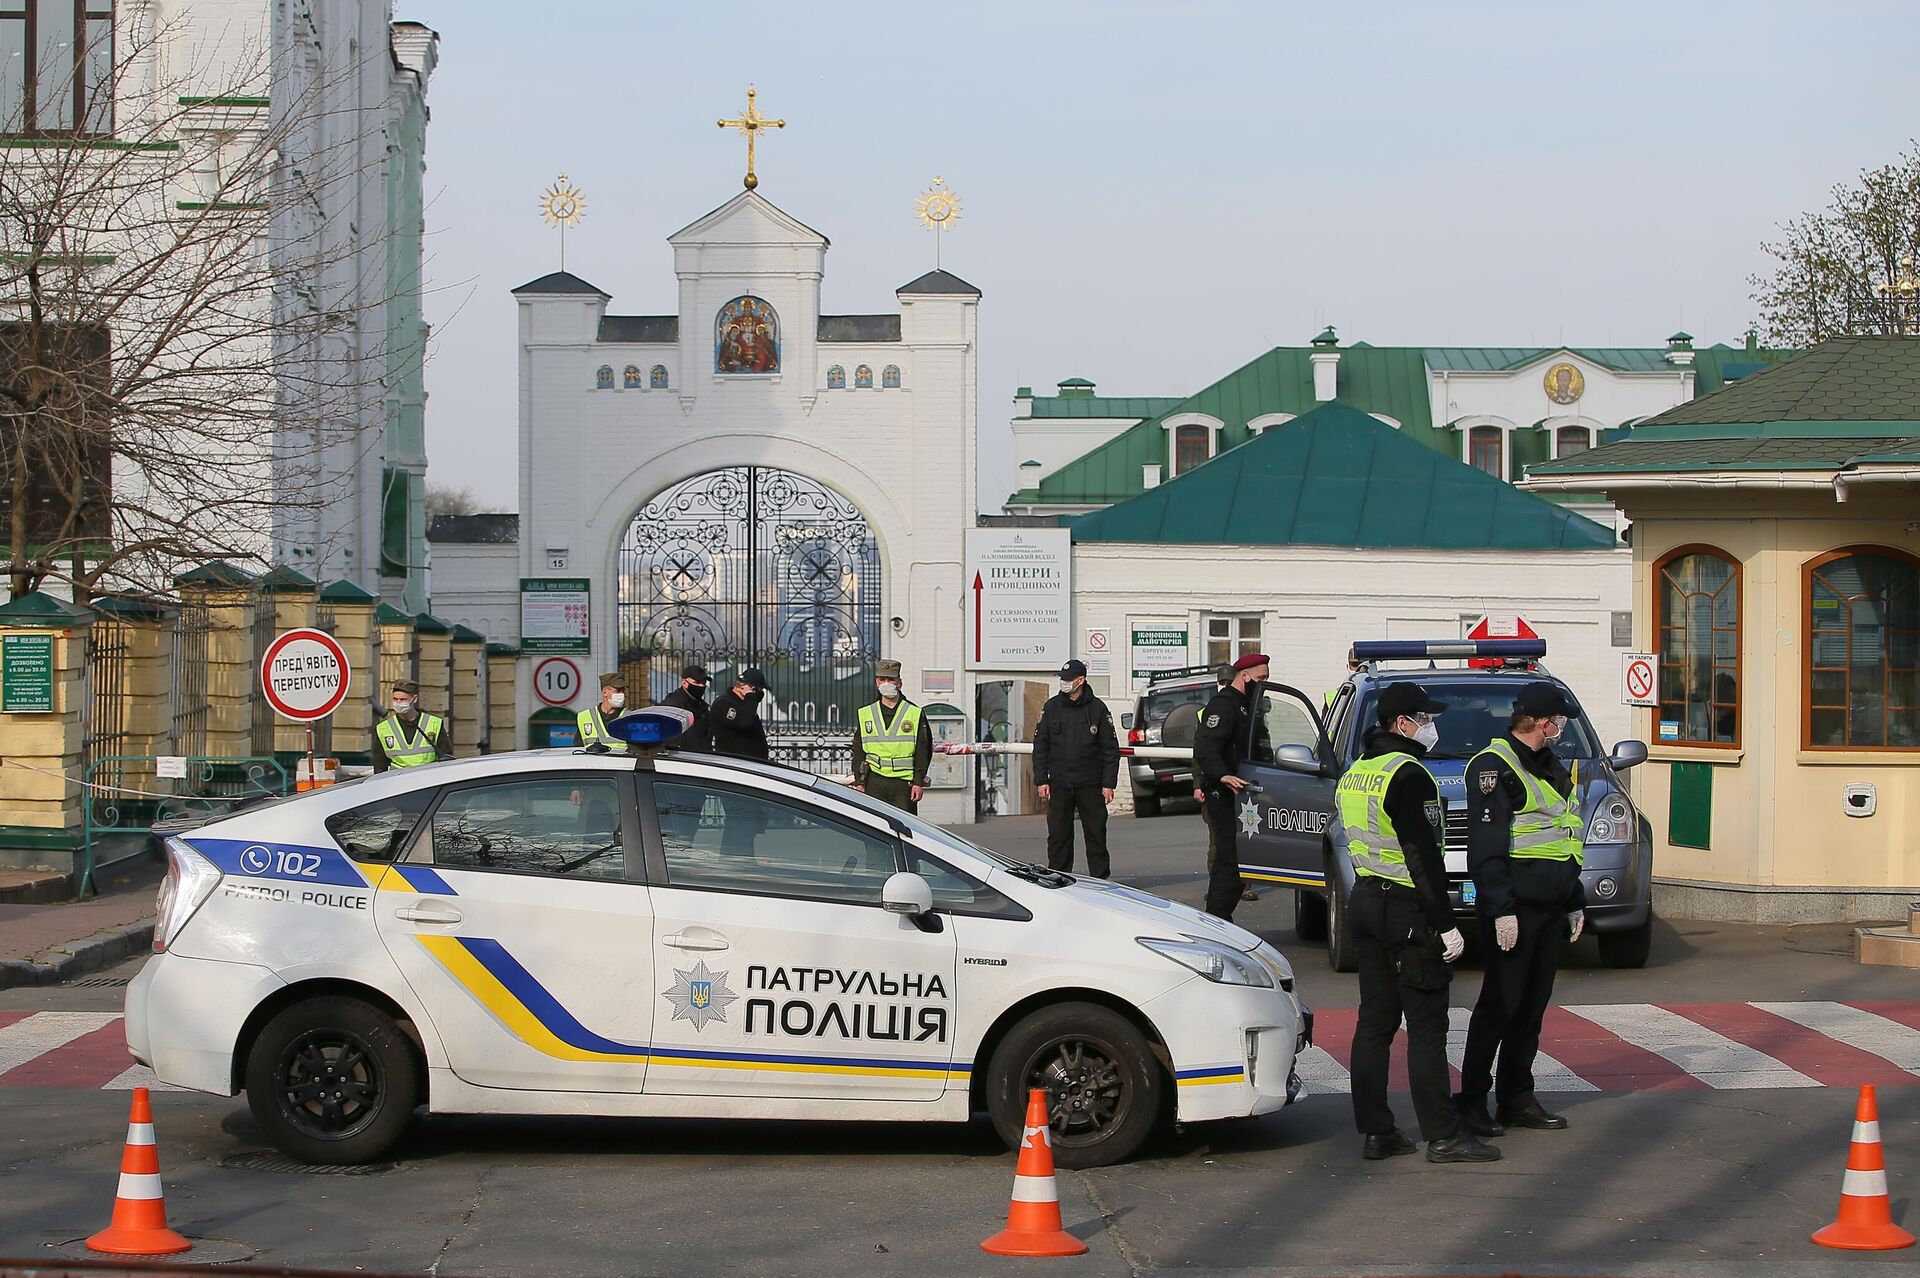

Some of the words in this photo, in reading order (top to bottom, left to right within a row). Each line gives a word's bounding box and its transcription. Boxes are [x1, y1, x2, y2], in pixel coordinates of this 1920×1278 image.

[552, 560, 564, 568] 15
[991, 567, 1050, 578] ПЕЧЕРИ
[990, 582, 1060, 590] ПРОВІДНИКОМ
[1033, 645, 1045, 654] 39
[275, 655, 336, 673] ПРЕД'ЯВІТЬ
[274, 674, 339, 692] ПЕРЕПУСТКУ
[544, 671, 570, 690] 10
[276, 851, 321, 877] 102
[225, 884, 295, 903] PATROL
[302, 892, 367, 910] POLICE
[964, 957, 1000, 965] HYBRID
[747, 965, 948, 998] ПАТРУЛЬНА
[745, 999, 946, 1042] ПОЛІЦІЯ
